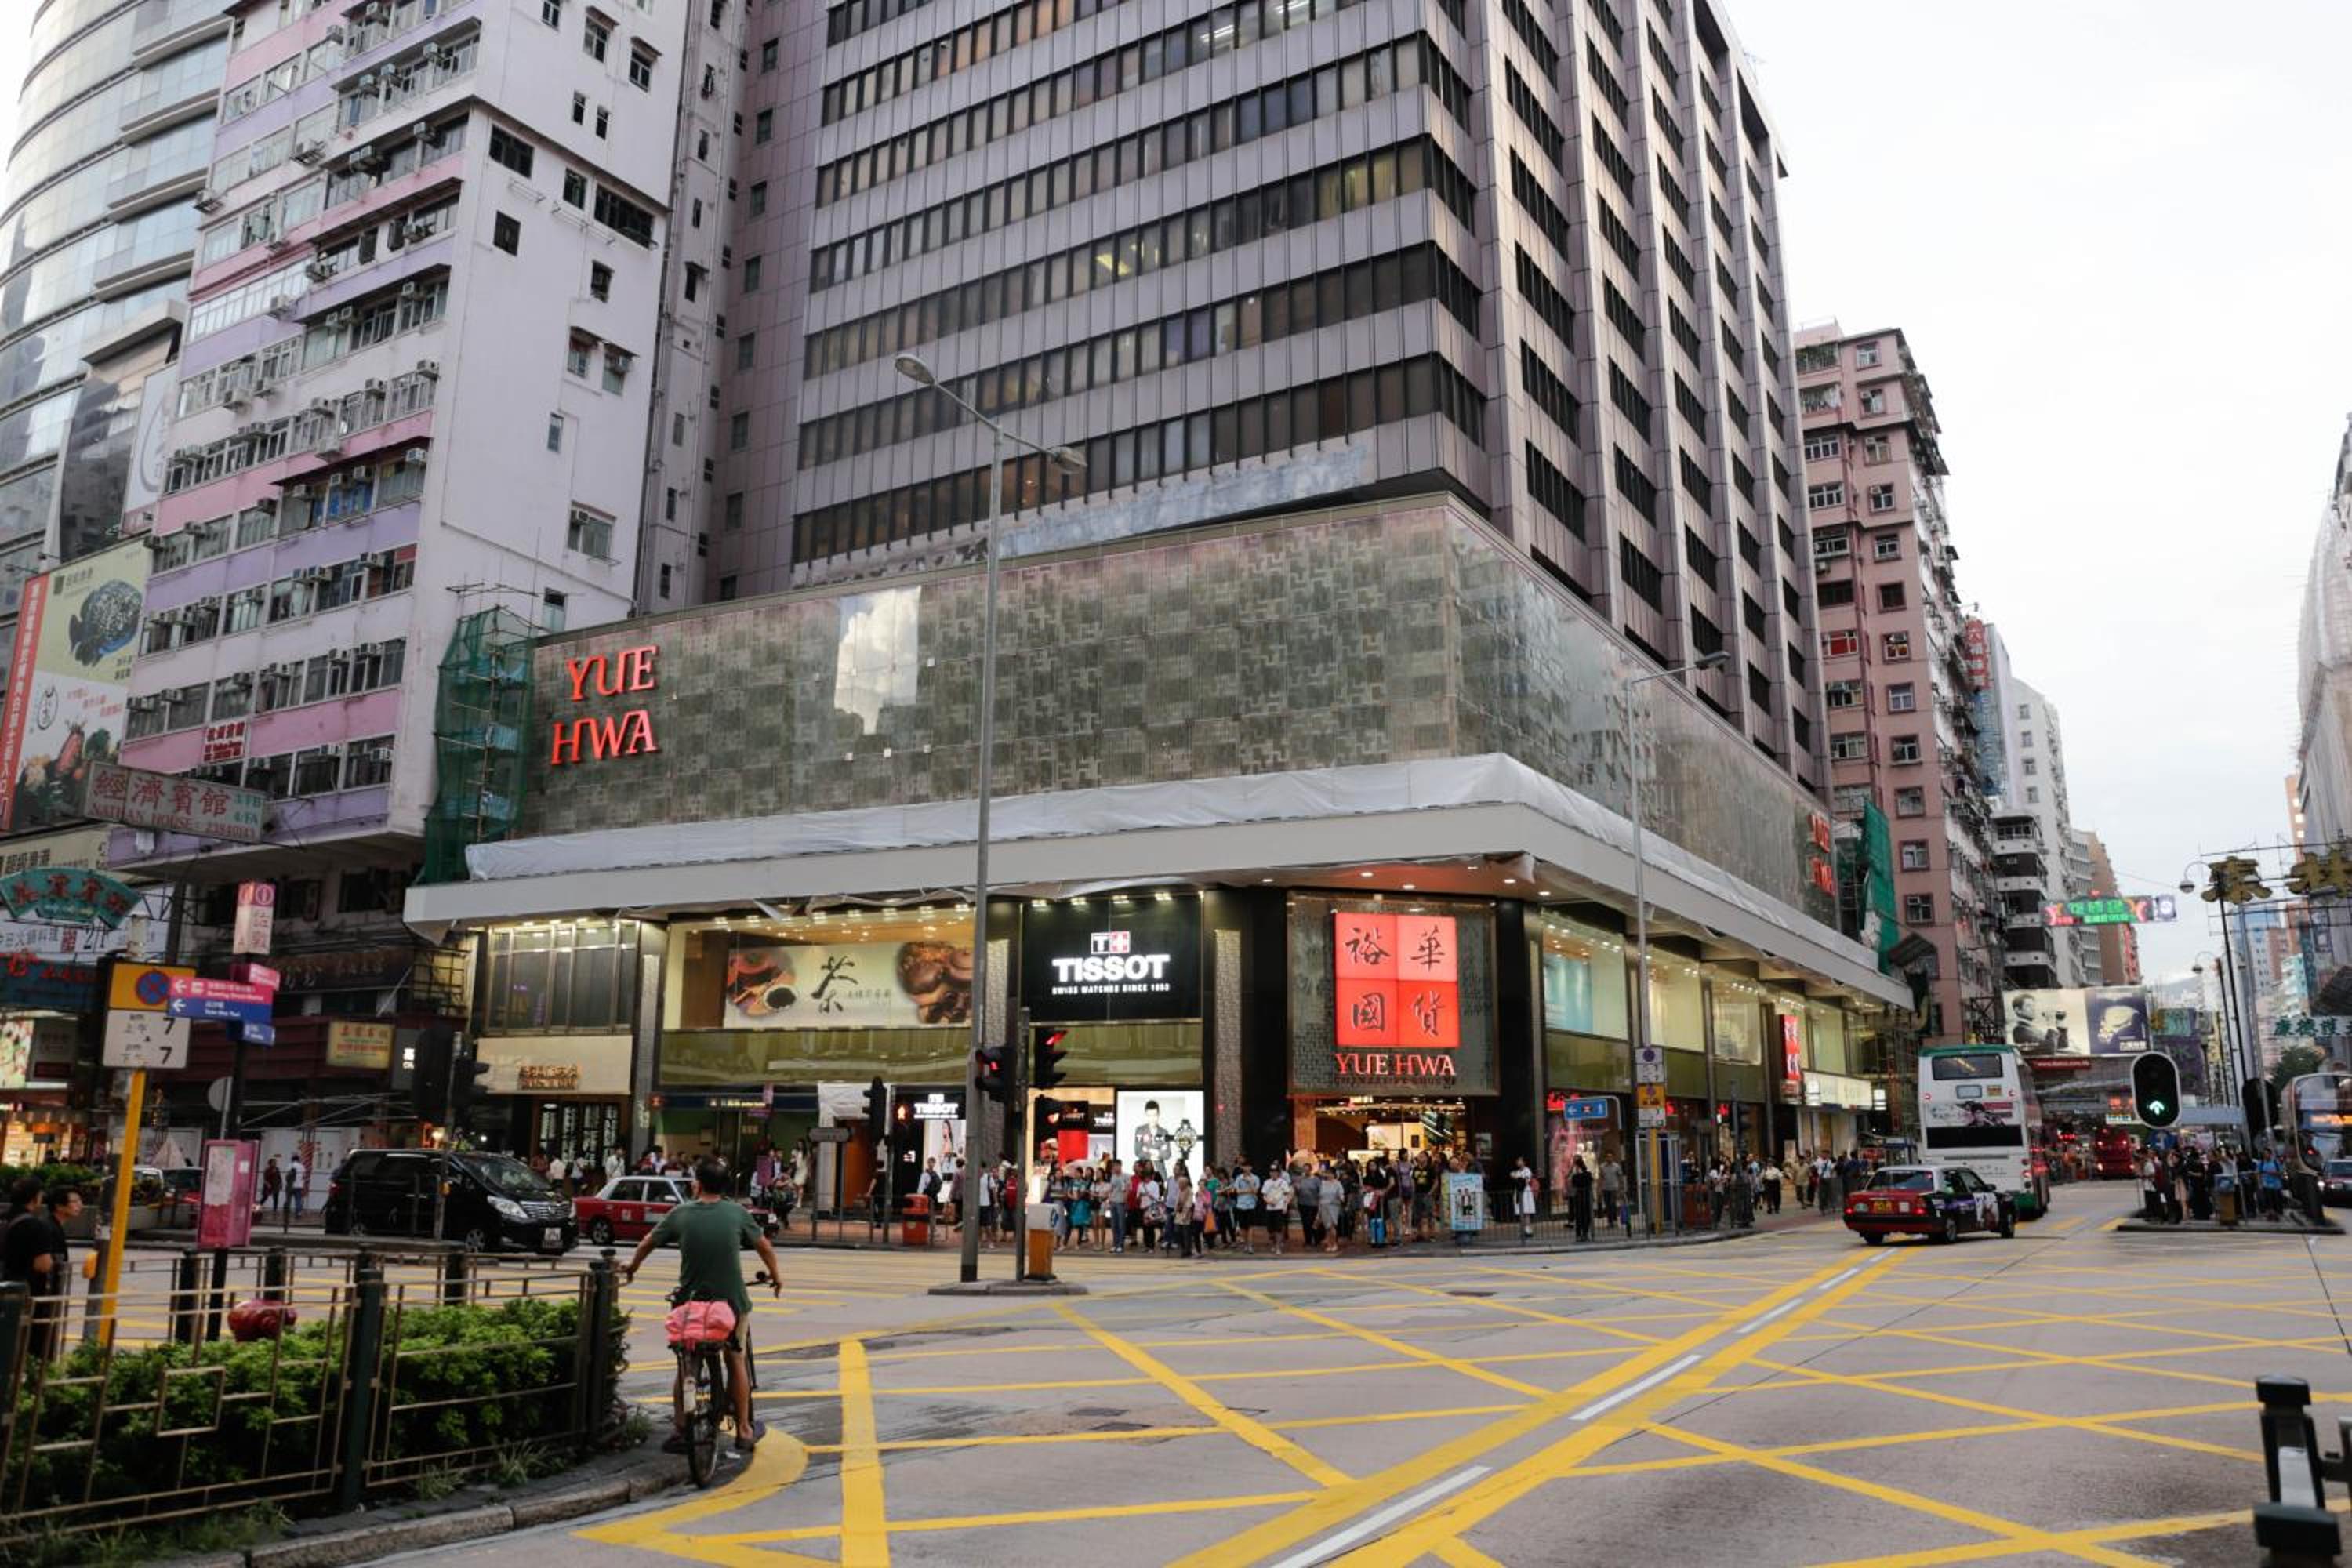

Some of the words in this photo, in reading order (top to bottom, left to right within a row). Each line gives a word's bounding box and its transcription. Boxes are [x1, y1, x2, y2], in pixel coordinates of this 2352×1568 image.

[566, 645, 659, 702] YUE
[551, 709, 659, 765] HWA
[93, 771, 229, 817] 經濟賓館
[1345, 924, 1445, 971] 裕華
[1051, 954, 1171, 982] TISSOT
[1052, 986, 1078, 995] SWISS
[1081, 985, 1119, 993] WATCHES
[1122, 984, 1148, 993] SINCE
[163, 1017, 176, 1035] 7
[1352, 991, 1445, 1036] 國貨
[159, 1046, 172, 1064] 7
[1335, 1053, 1388, 1075] YUE
[1394, 1054, 1456, 1076] HWA
[913, 1103, 958, 1113] TISSOT
